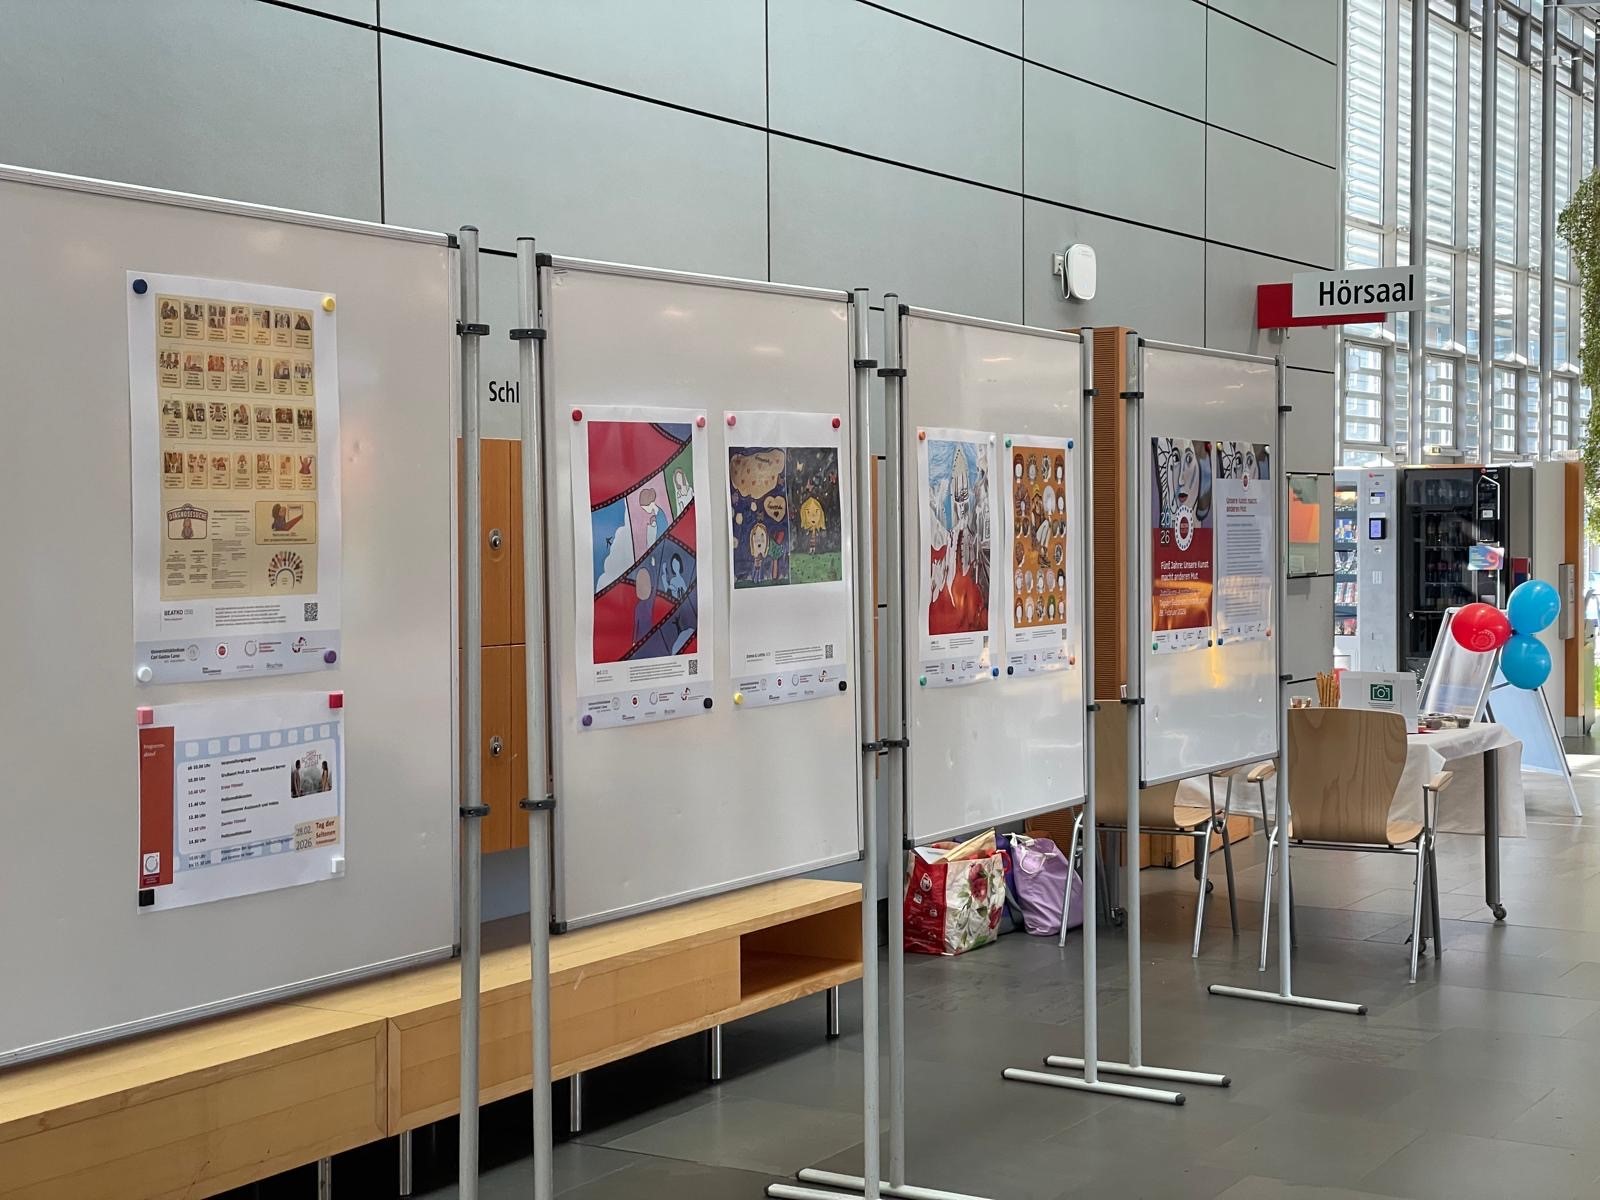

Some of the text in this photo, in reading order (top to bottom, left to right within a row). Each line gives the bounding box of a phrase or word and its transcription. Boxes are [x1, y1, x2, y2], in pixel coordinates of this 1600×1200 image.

[1319, 274, 1414, 306] Hörsaal
[1160, 512, 1170, 526] 20
[1160, 530, 1170, 544] 26
[315, 822, 325, 830] Tag
[295, 837, 313, 851] 2026
